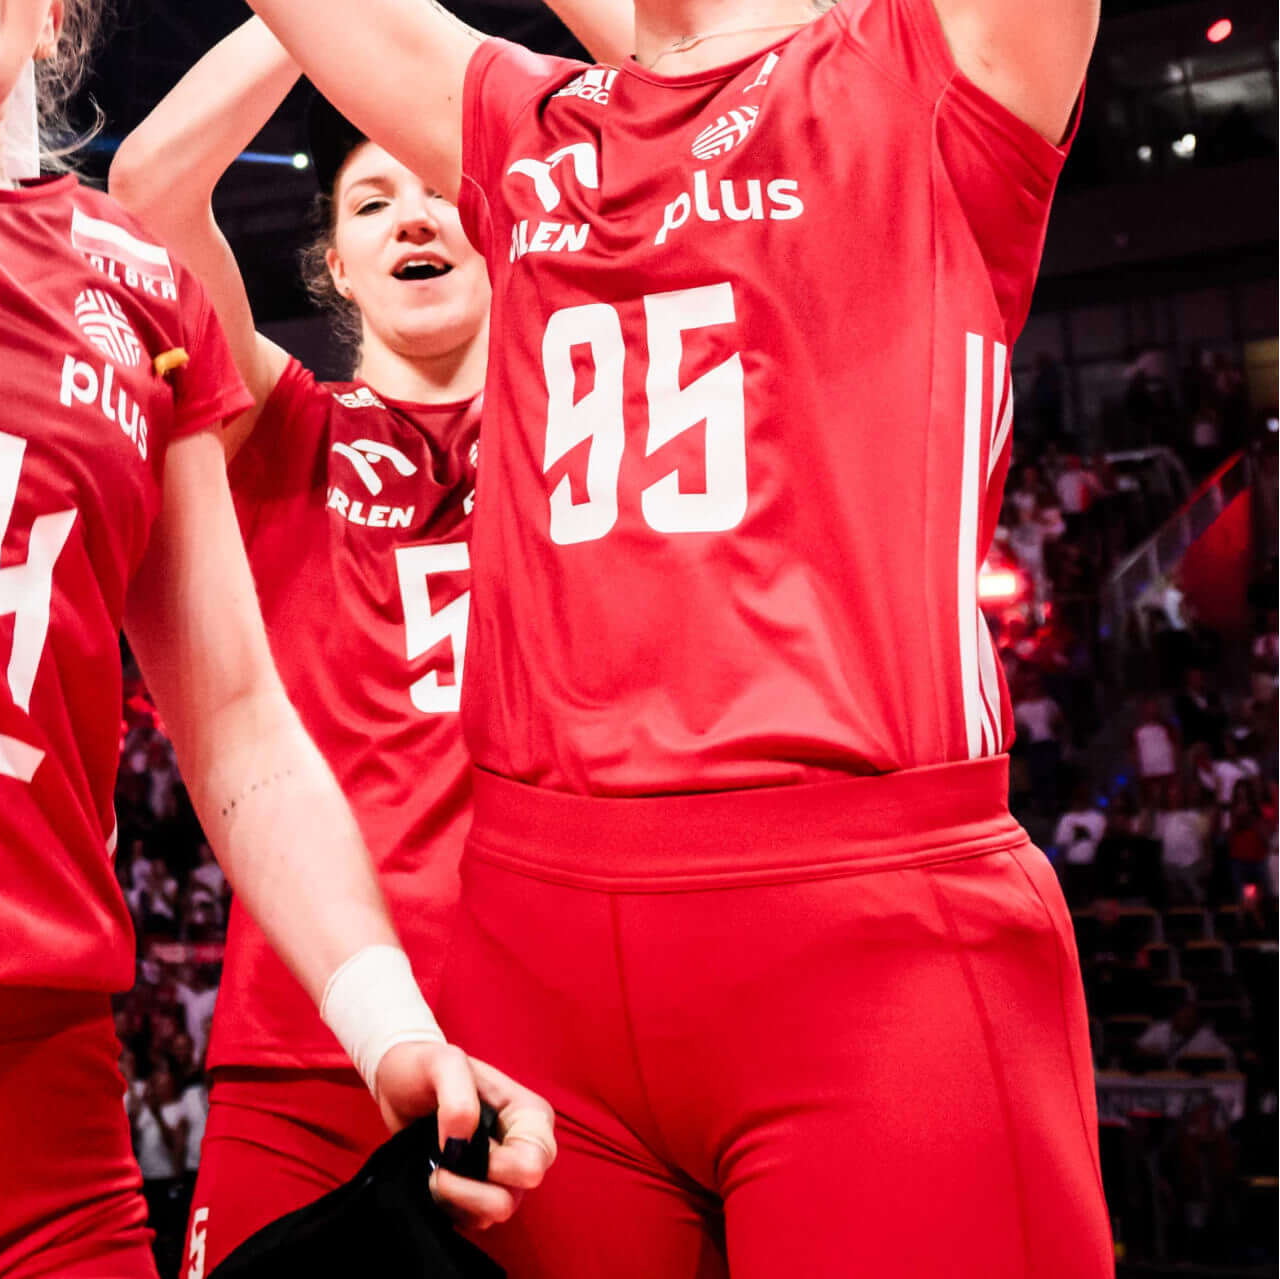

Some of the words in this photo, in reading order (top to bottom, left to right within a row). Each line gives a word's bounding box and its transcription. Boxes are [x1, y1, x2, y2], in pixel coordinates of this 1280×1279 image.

[509, 219, 590, 264] LEN
[653, 169, 804, 246] plus
[59, 353, 148, 462] plus
[541, 282, 749, 546] 95
[327, 487, 416, 529] RLEN
[395, 541, 472, 714] 5
